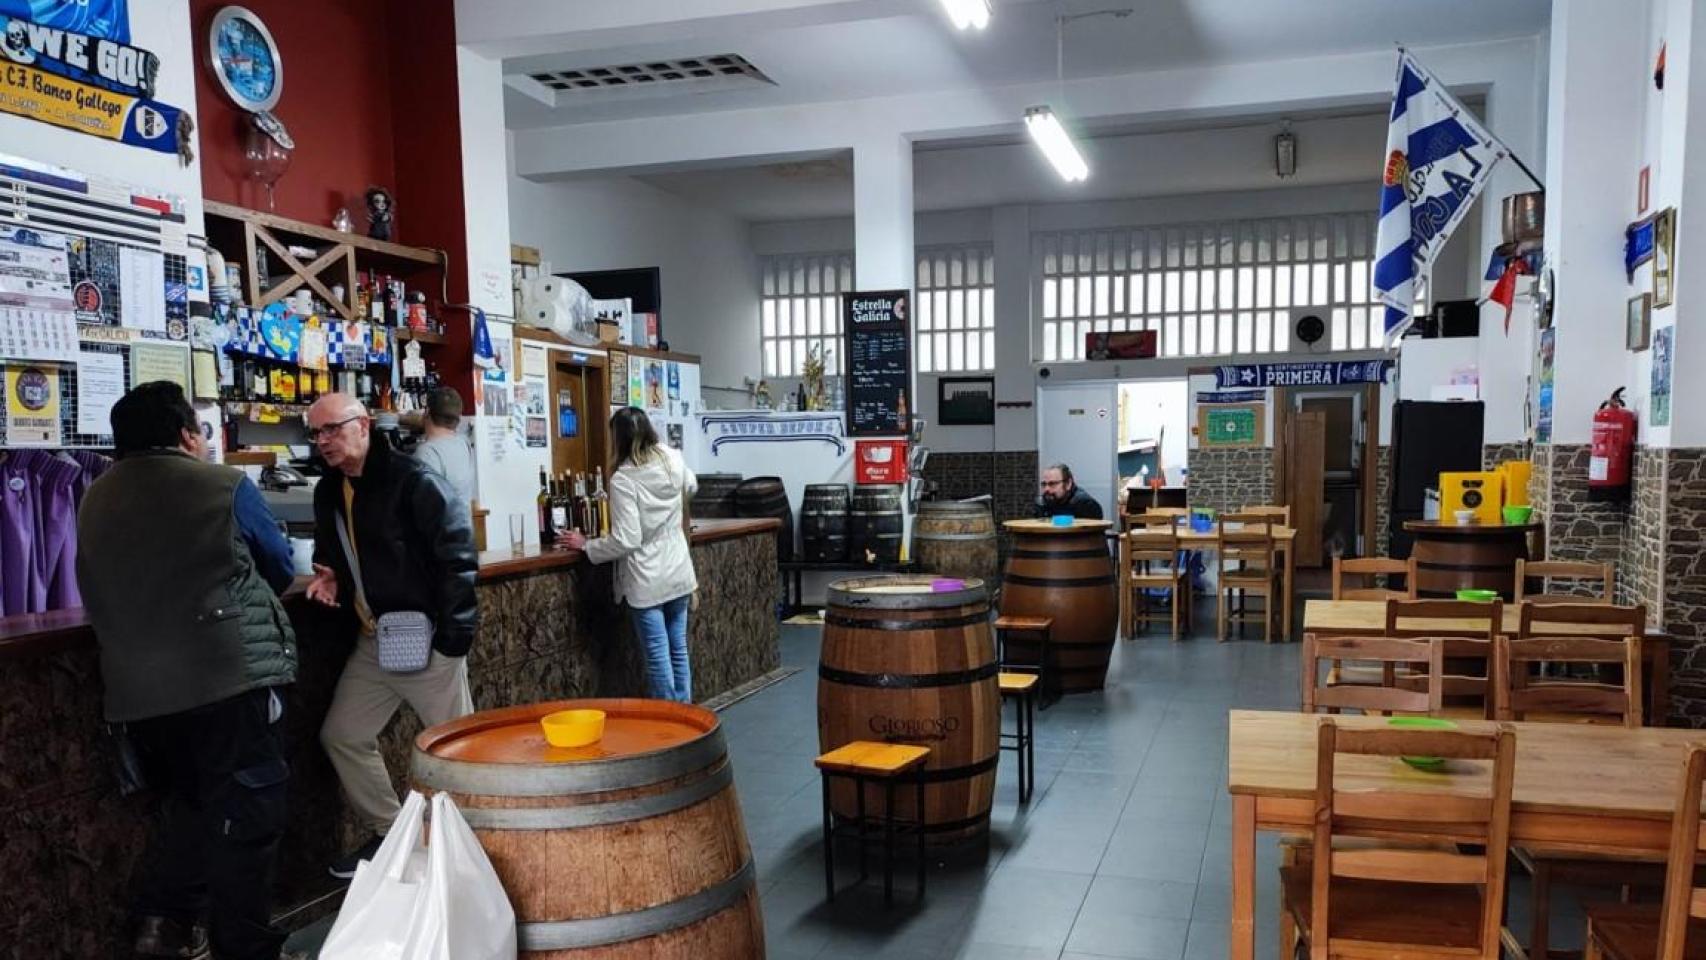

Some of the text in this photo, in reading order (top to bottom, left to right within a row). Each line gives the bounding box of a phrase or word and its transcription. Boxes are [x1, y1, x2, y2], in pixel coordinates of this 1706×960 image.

[27, 22, 149, 90] WE GO!
[32, 72, 72, 102] Banco
[76, 87, 121, 118] Gallego
[852, 299, 892, 311] Estrella
[852, 310, 891, 323] Galicia
[1266, 370, 1332, 385] PRIMERA
